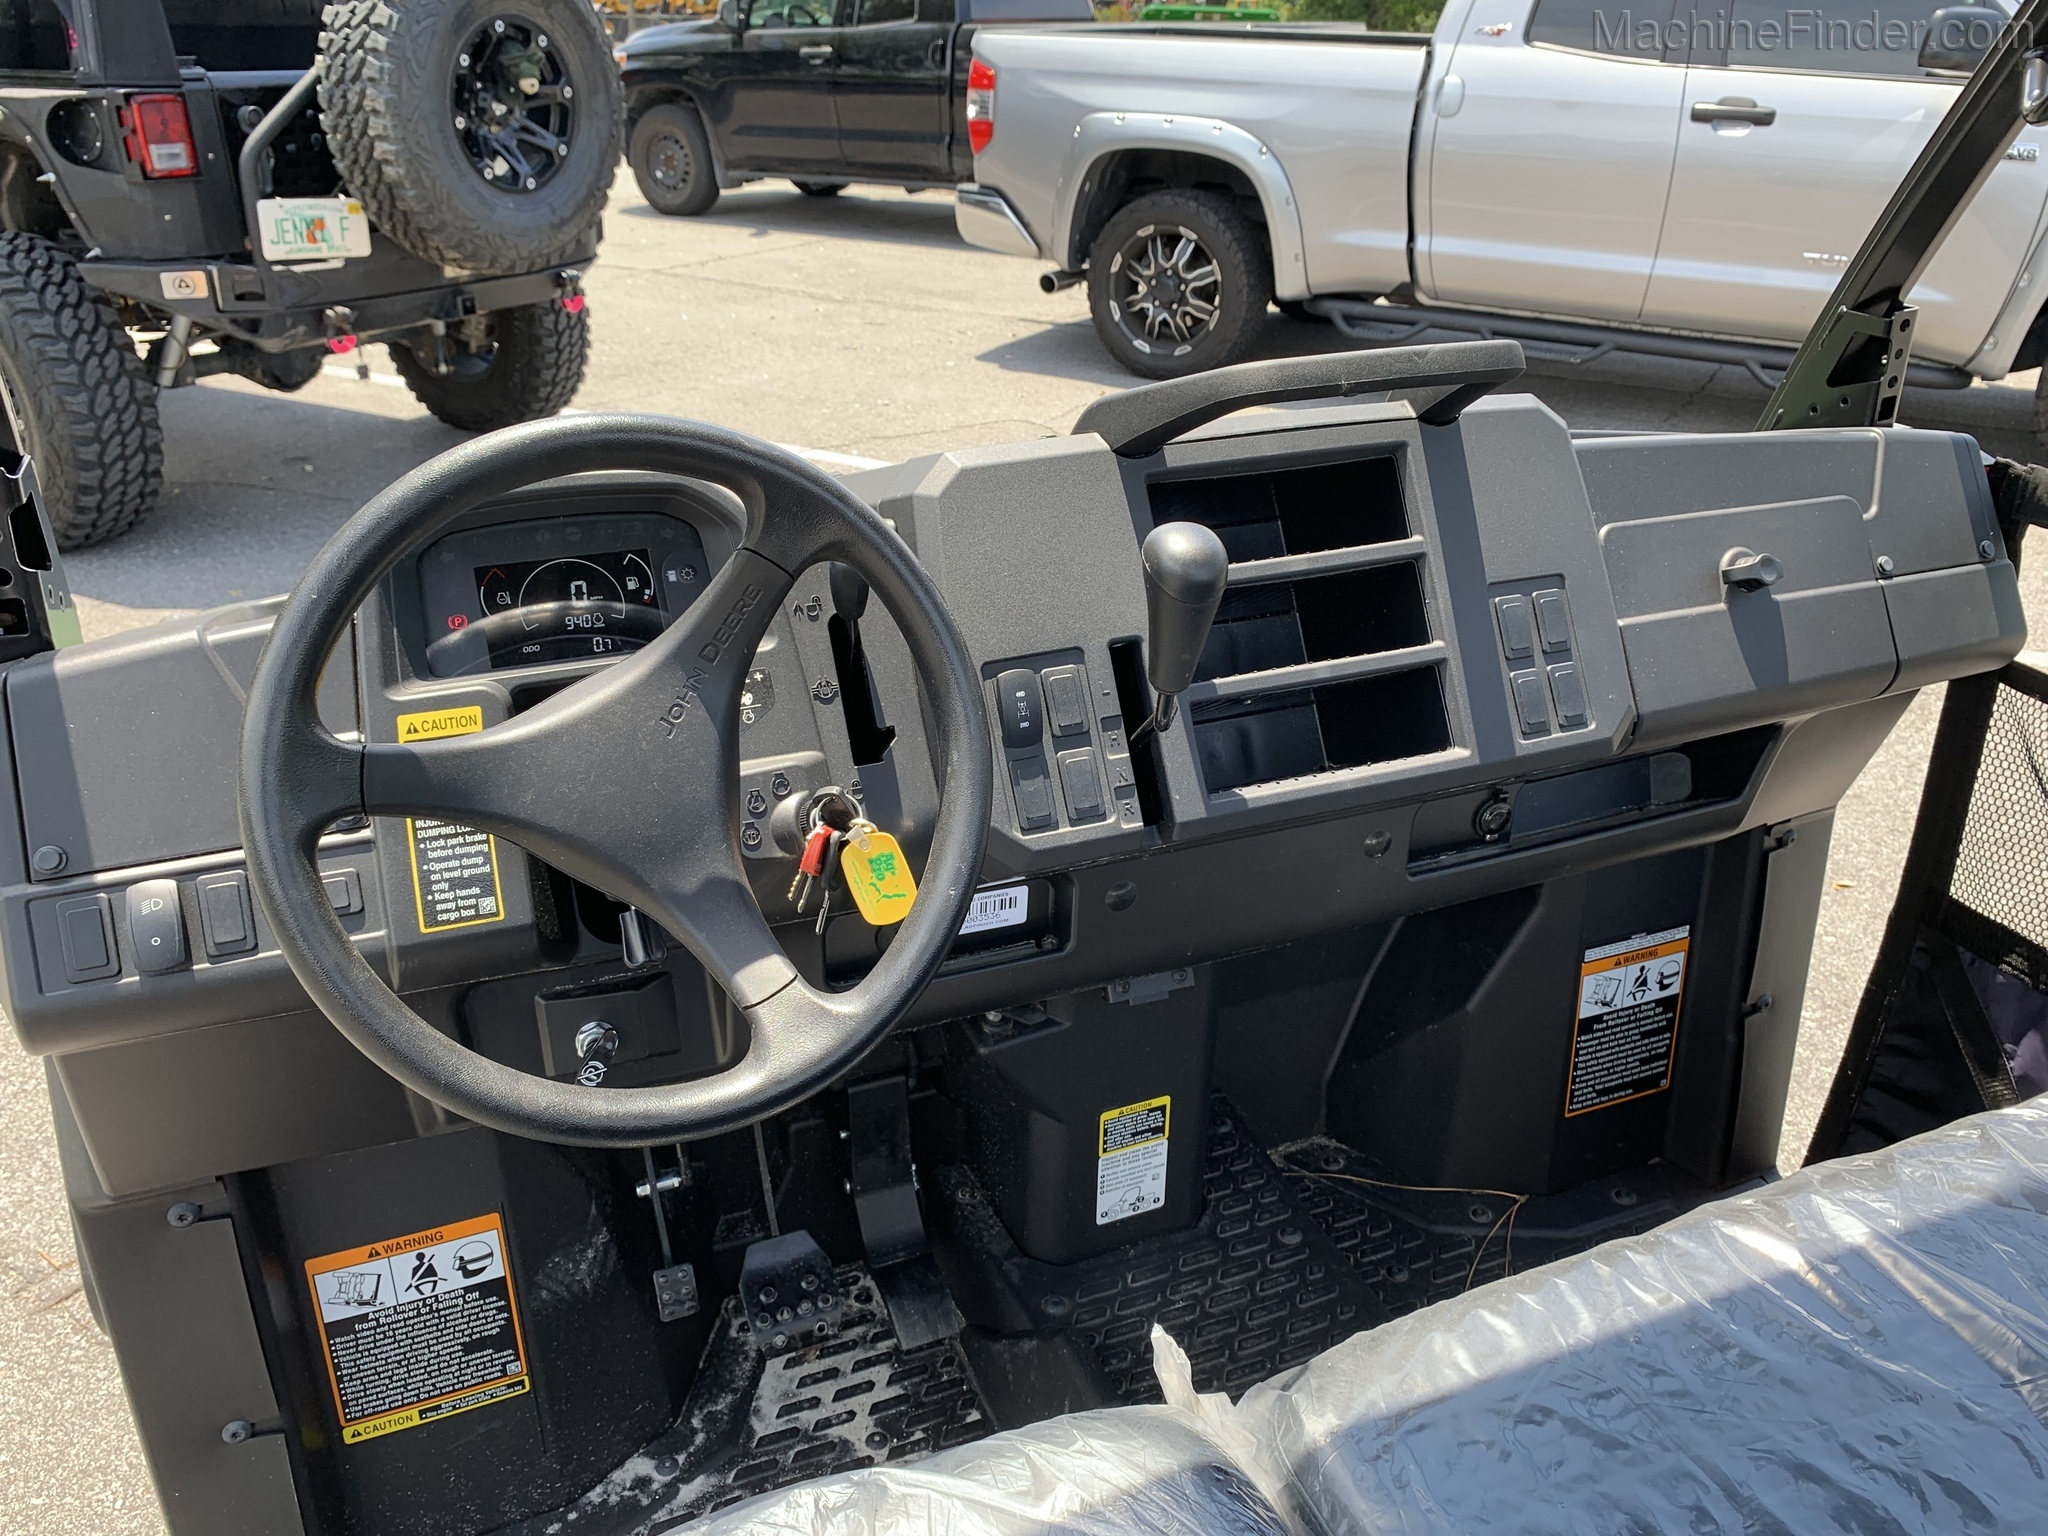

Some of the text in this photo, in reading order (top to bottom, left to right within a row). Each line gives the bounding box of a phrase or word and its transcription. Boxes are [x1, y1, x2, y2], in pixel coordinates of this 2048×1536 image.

[570, 580, 588, 608] 0
[565, 614, 592, 630] 940
[522, 645, 540, 653] ODO
[659, 583, 764, 739] JOHN DEERE
[421, 714, 477, 732] CAUTION
[417, 825, 455, 839] DUMPING
[427, 832, 487, 848] Lock park brake
[428, 842, 488, 859] before dumping
[430, 855, 483, 872] Operate dump
[443, 869, 461, 879] level
[463, 864, 490, 877] ground
[432, 881, 449, 893] only
[434, 886, 480, 902] Keep hands
[977, 892, 1009, 902] COMPANIES
[436, 898, 476, 912] away from
[438, 907, 475, 923] cargo box
[1623, 948, 1659, 964] WARNING
[1126, 1102, 1152, 1113] CAUTION
[382, 1231, 444, 1255] WARNING
[355, 1320, 377, 1331] from
[379, 1309, 418, 1324] Rollover
[432, 1296, 464, 1312] Falling
[465, 1292, 480, 1301] Off
[368, 1307, 394, 1320] Avoid
[397, 1300, 423, 1314] Injury
[438, 1289, 464, 1301] Death
[335, 1334, 355, 1343] Watch
[357, 1328, 374, 1337] video
[390, 1320, 404, 1328] read
[406, 1311, 438, 1325] operator's
[440, 1305, 462, 1315] manual
[464, 1299, 483, 1308] before
[337, 1340, 356, 1350] Driver
[358, 1336, 374, 1344] must
[395, 1326, 412, 1335] years
[426, 1318, 439, 1326] with
[446, 1312, 461, 1320] valid
[463, 1306, 481, 1316] driver
[483, 1300, 506, 1310] license.
[338, 1347, 356, 1356] Never
[358, 1342, 374, 1350] drive
[376, 1336, 394, 1346] under
[408, 1325, 436, 1337] influence
[446, 1316, 469, 1326] alcohol
[479, 1308, 498, 1319] drugs.
[342, 1367, 358, 1375] Wear
[360, 1359, 385, 1370] helmets
[387, 1354, 404, 1362] when
[406, 1347, 428, 1358] driving
[430, 1335, 471, 1352] aggressively,
[482, 1327, 500, 1338] rough
[352, 1369, 375, 1379] uneven
[377, 1362, 400, 1373] terrain,
[417, 1351, 438, 1362] higher
[439, 1344, 463, 1356] speeds.
[345, 1379, 361, 1388] Keep
[380, 1370, 392, 1378] and
[394, 1366, 407, 1375] legs
[409, 1360, 428, 1370] inside
[429, 1354, 450, 1365] during
[346, 1384, 364, 1393] While
[366, 1377, 391, 1389] turning,
[392, 1372, 409, 1381] drive
[410, 1367, 425, 1376] slow
[461, 1348, 494, 1361] accelerate.
[348, 1391, 364, 1399] Drive
[366, 1385, 386, 1395] slowly
[388, 1379, 405, 1388] when
[406, 1372, 430, 1384] loaded,
[441, 1364, 459, 1374] rough
[469, 1356, 491, 1365] uneven
[492, 1348, 514, 1360] terrain,
[350, 1364, 503, 1412] Use brakes going down hills. Vehicle may freewheel.
[364, 1403, 389, 1414] off-road
[403, 1395, 418, 1404] only.
[464, 1377, 482, 1387] public
[484, 1371, 503, 1380] roads.
[363, 1414, 413, 1435] CAUTION
